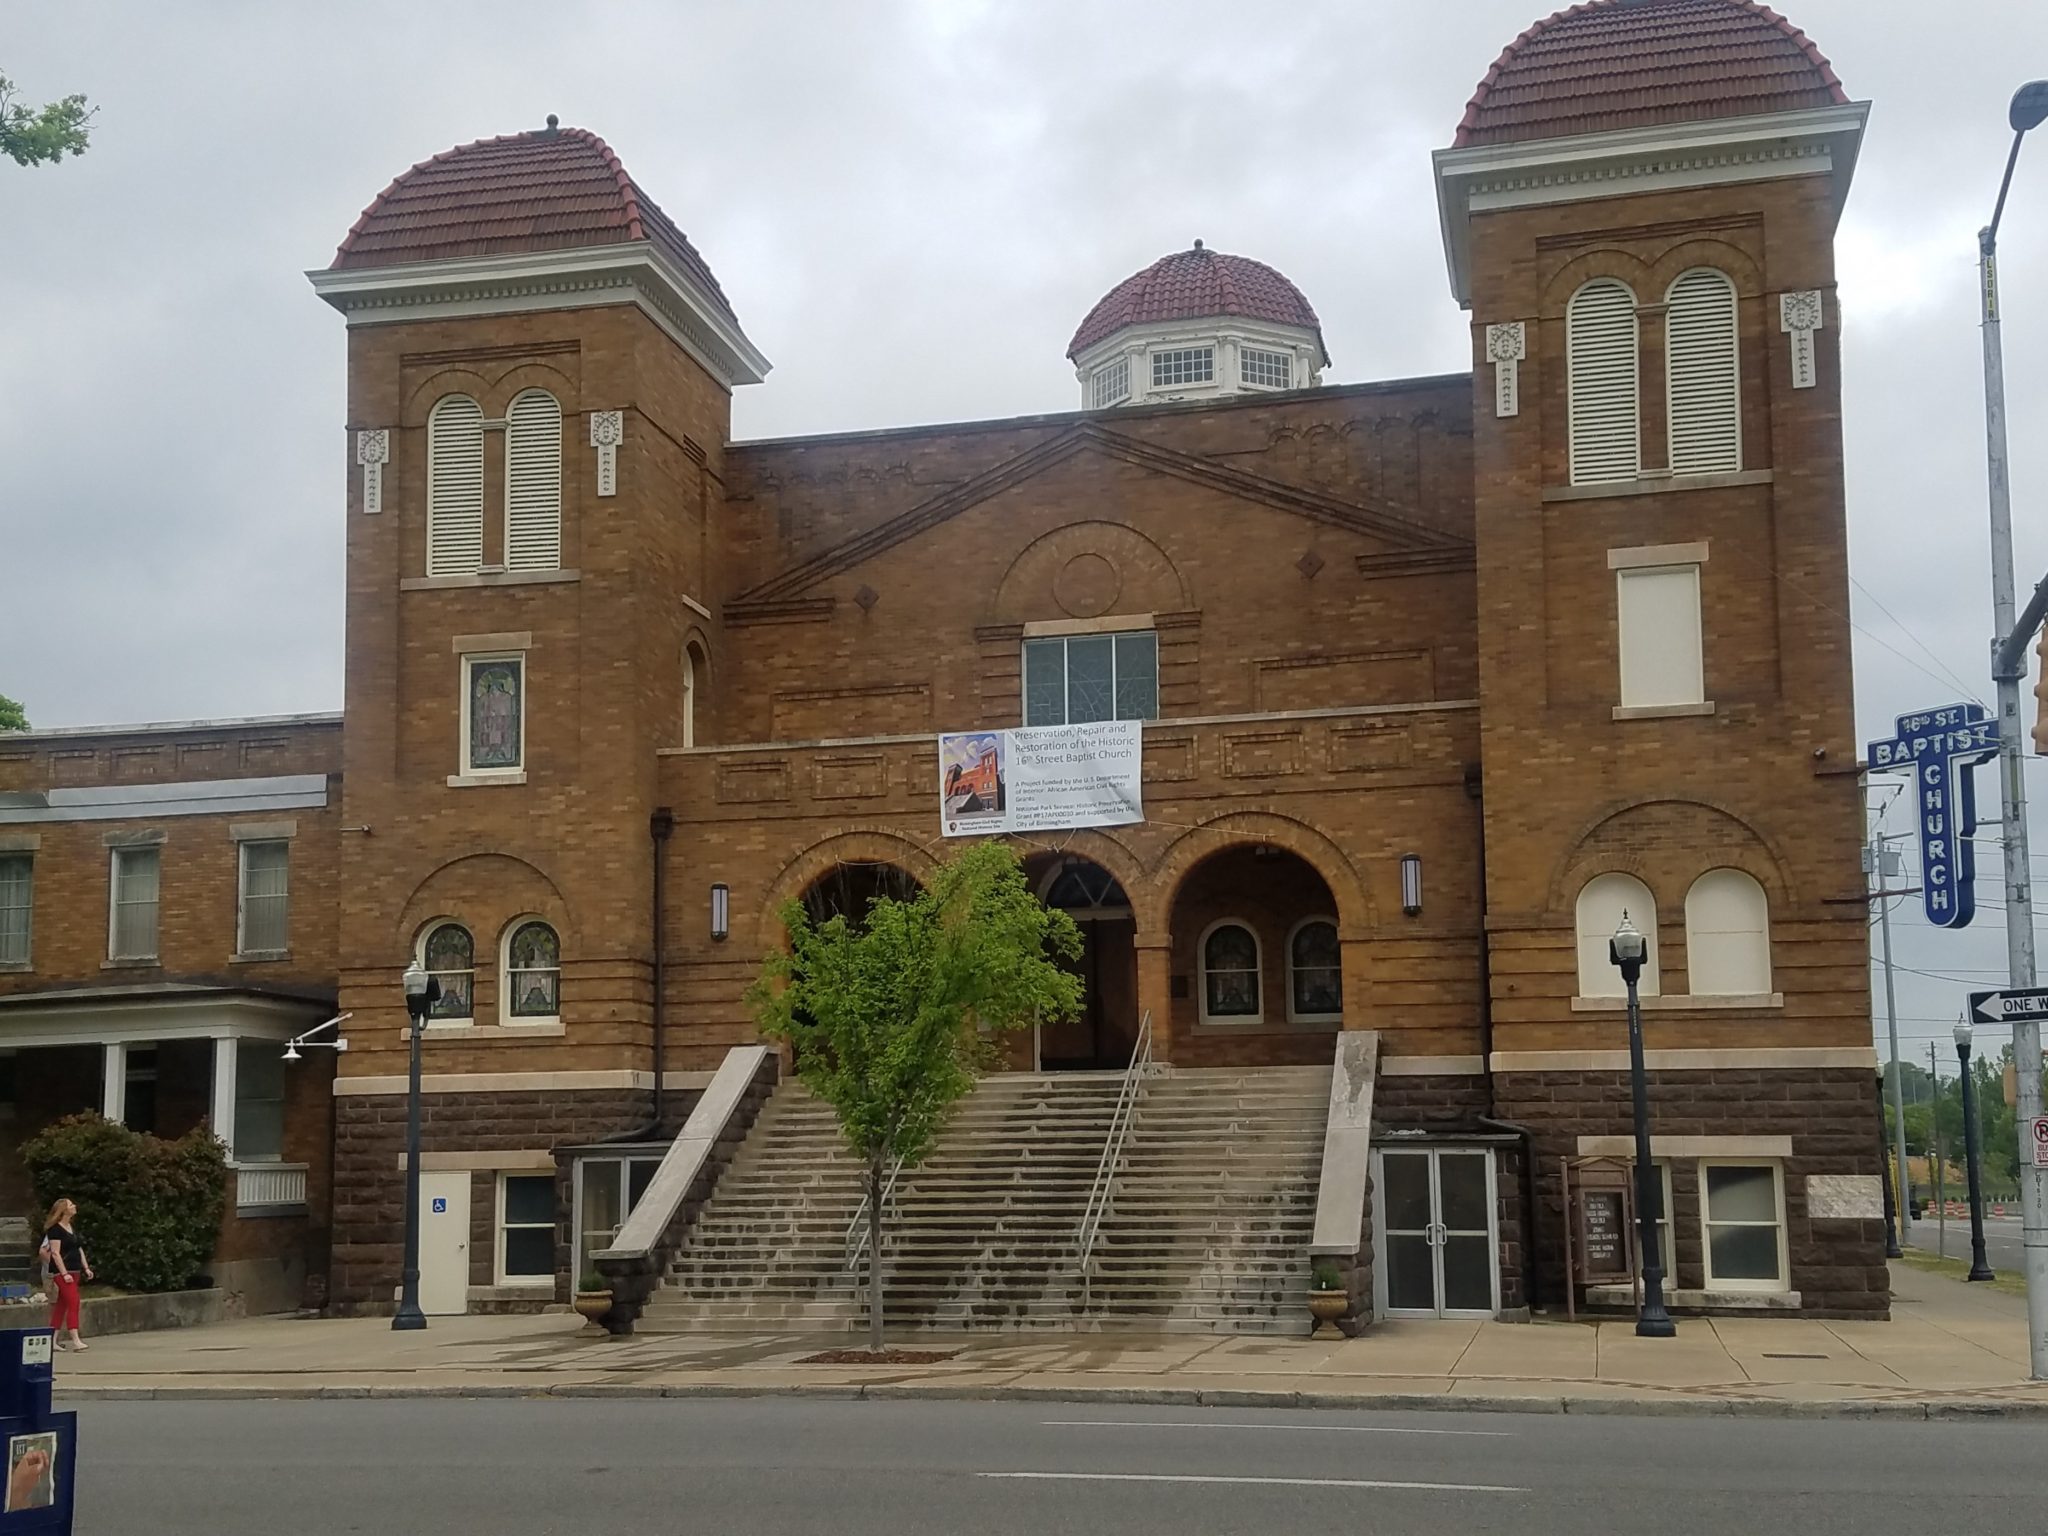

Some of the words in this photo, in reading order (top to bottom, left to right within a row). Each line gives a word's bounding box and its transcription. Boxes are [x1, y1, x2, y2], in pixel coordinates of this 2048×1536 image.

[1015, 728, 1075, 740] Preservation,
[1077, 725, 1106, 737] Repair
[1109, 724, 1127, 734] and
[1015, 741, 1067, 753] Restoration
[1070, 739, 1079, 750] of
[1081, 739, 1096, 749] the
[1098, 737, 1134, 746] Historic
[1876, 725, 1989, 764] BAPTIST
[1016, 755, 1033, 766] 16th
[1035, 754, 1063, 765] Street
[1066, 751, 1096, 763] Baptist
[1098, 749, 1132, 759] Church
[1021, 780, 1041, 788] Project
[1042, 778, 1062, 786] funded
[1064, 778, 1072, 786] by
[1096, 774, 1130, 782] Department
[1087, 807, 1116, 816] supported
[1015, 820, 1028, 829] City
[1036, 818, 1071, 826] Birmingham
[1924, 764, 1948, 911] CHURCH
[2003, 998, 2033, 1012] ONE
